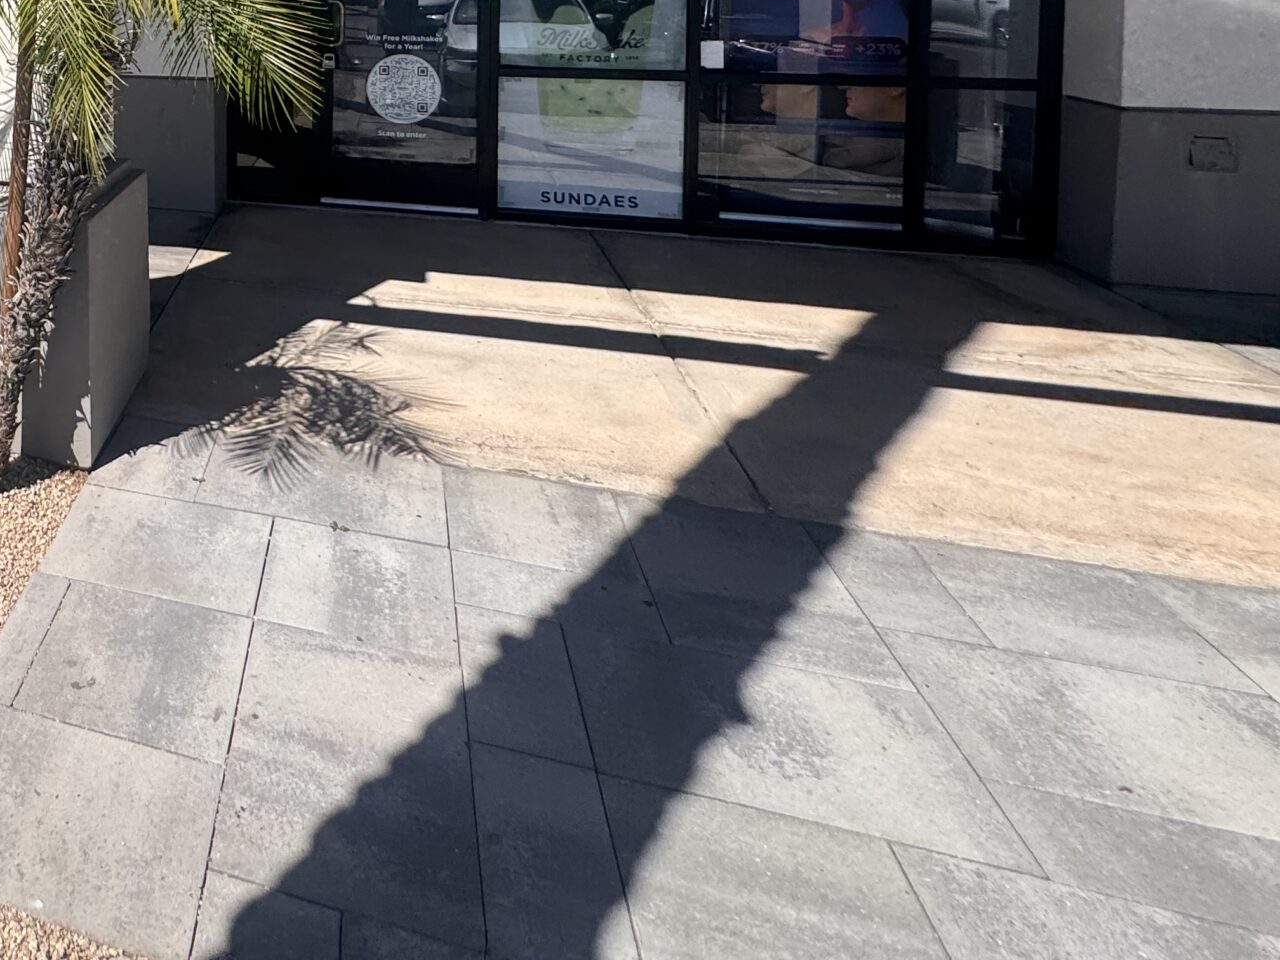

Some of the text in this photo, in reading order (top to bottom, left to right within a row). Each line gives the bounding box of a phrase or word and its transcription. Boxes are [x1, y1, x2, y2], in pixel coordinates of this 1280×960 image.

[401, 34, 443, 42] Milkshakes
[856, 43, 901, 56] +23%
[559, 53, 620, 63] FACTORY
[540, 190, 639, 209] SUNDAES
